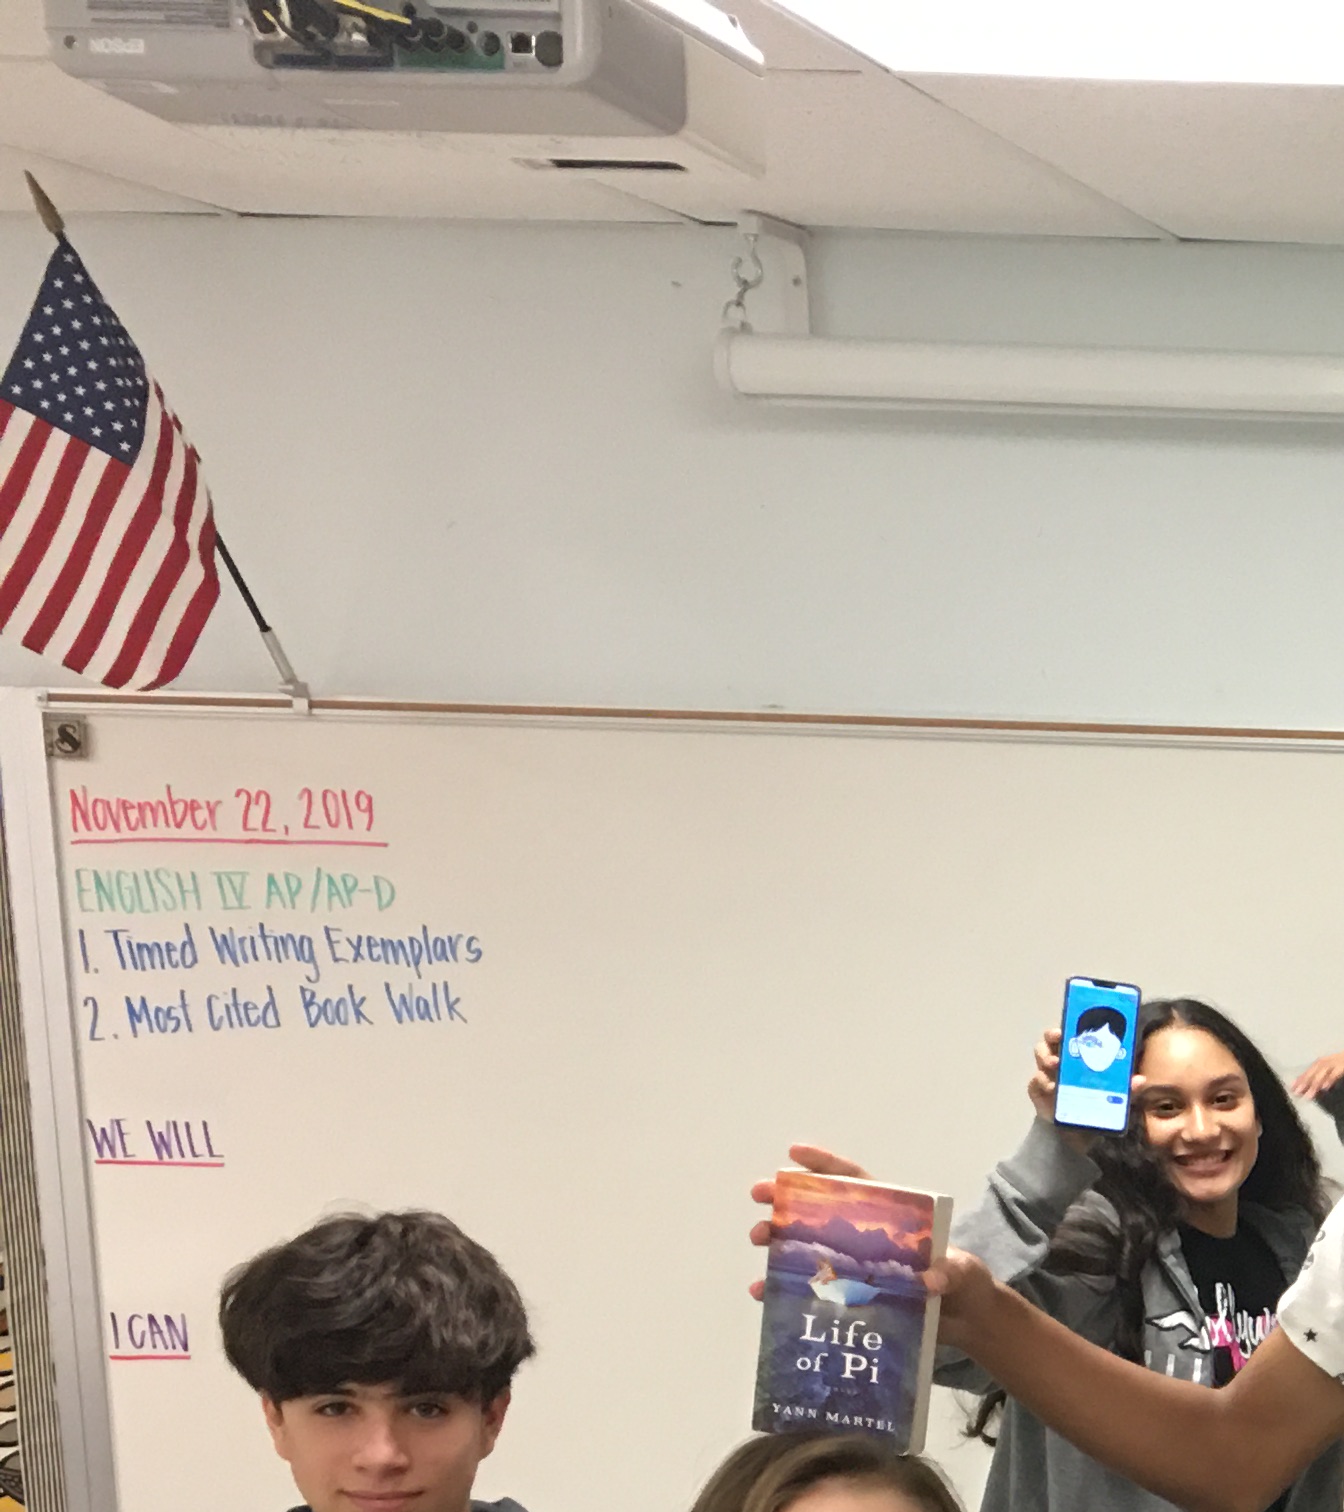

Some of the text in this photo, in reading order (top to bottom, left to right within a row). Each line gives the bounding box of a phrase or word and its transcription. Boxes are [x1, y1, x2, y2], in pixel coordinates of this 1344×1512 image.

[71, 785, 375, 837] November 22, 2019
[75, 867, 201, 914] ENGLISH
[211, 870, 250, 911] IV
[104, 923, 198, 970] Timed
[210, 925, 320, 982] Writing
[325, 926, 483, 980] Exemplars
[126, 991, 194, 1038] Most
[206, 984, 281, 1031] Cited
[299, 985, 374, 1030] Book
[384, 980, 468, 1027] Walk
[86, 1118, 225, 1159] WE WILL
[110, 1312, 190, 1354] I CAN
[800, 1313, 883, 1350] Life
[796, 1351, 880, 1384] of Pi
[772, 1402, 896, 1432] YANN MARTEL
